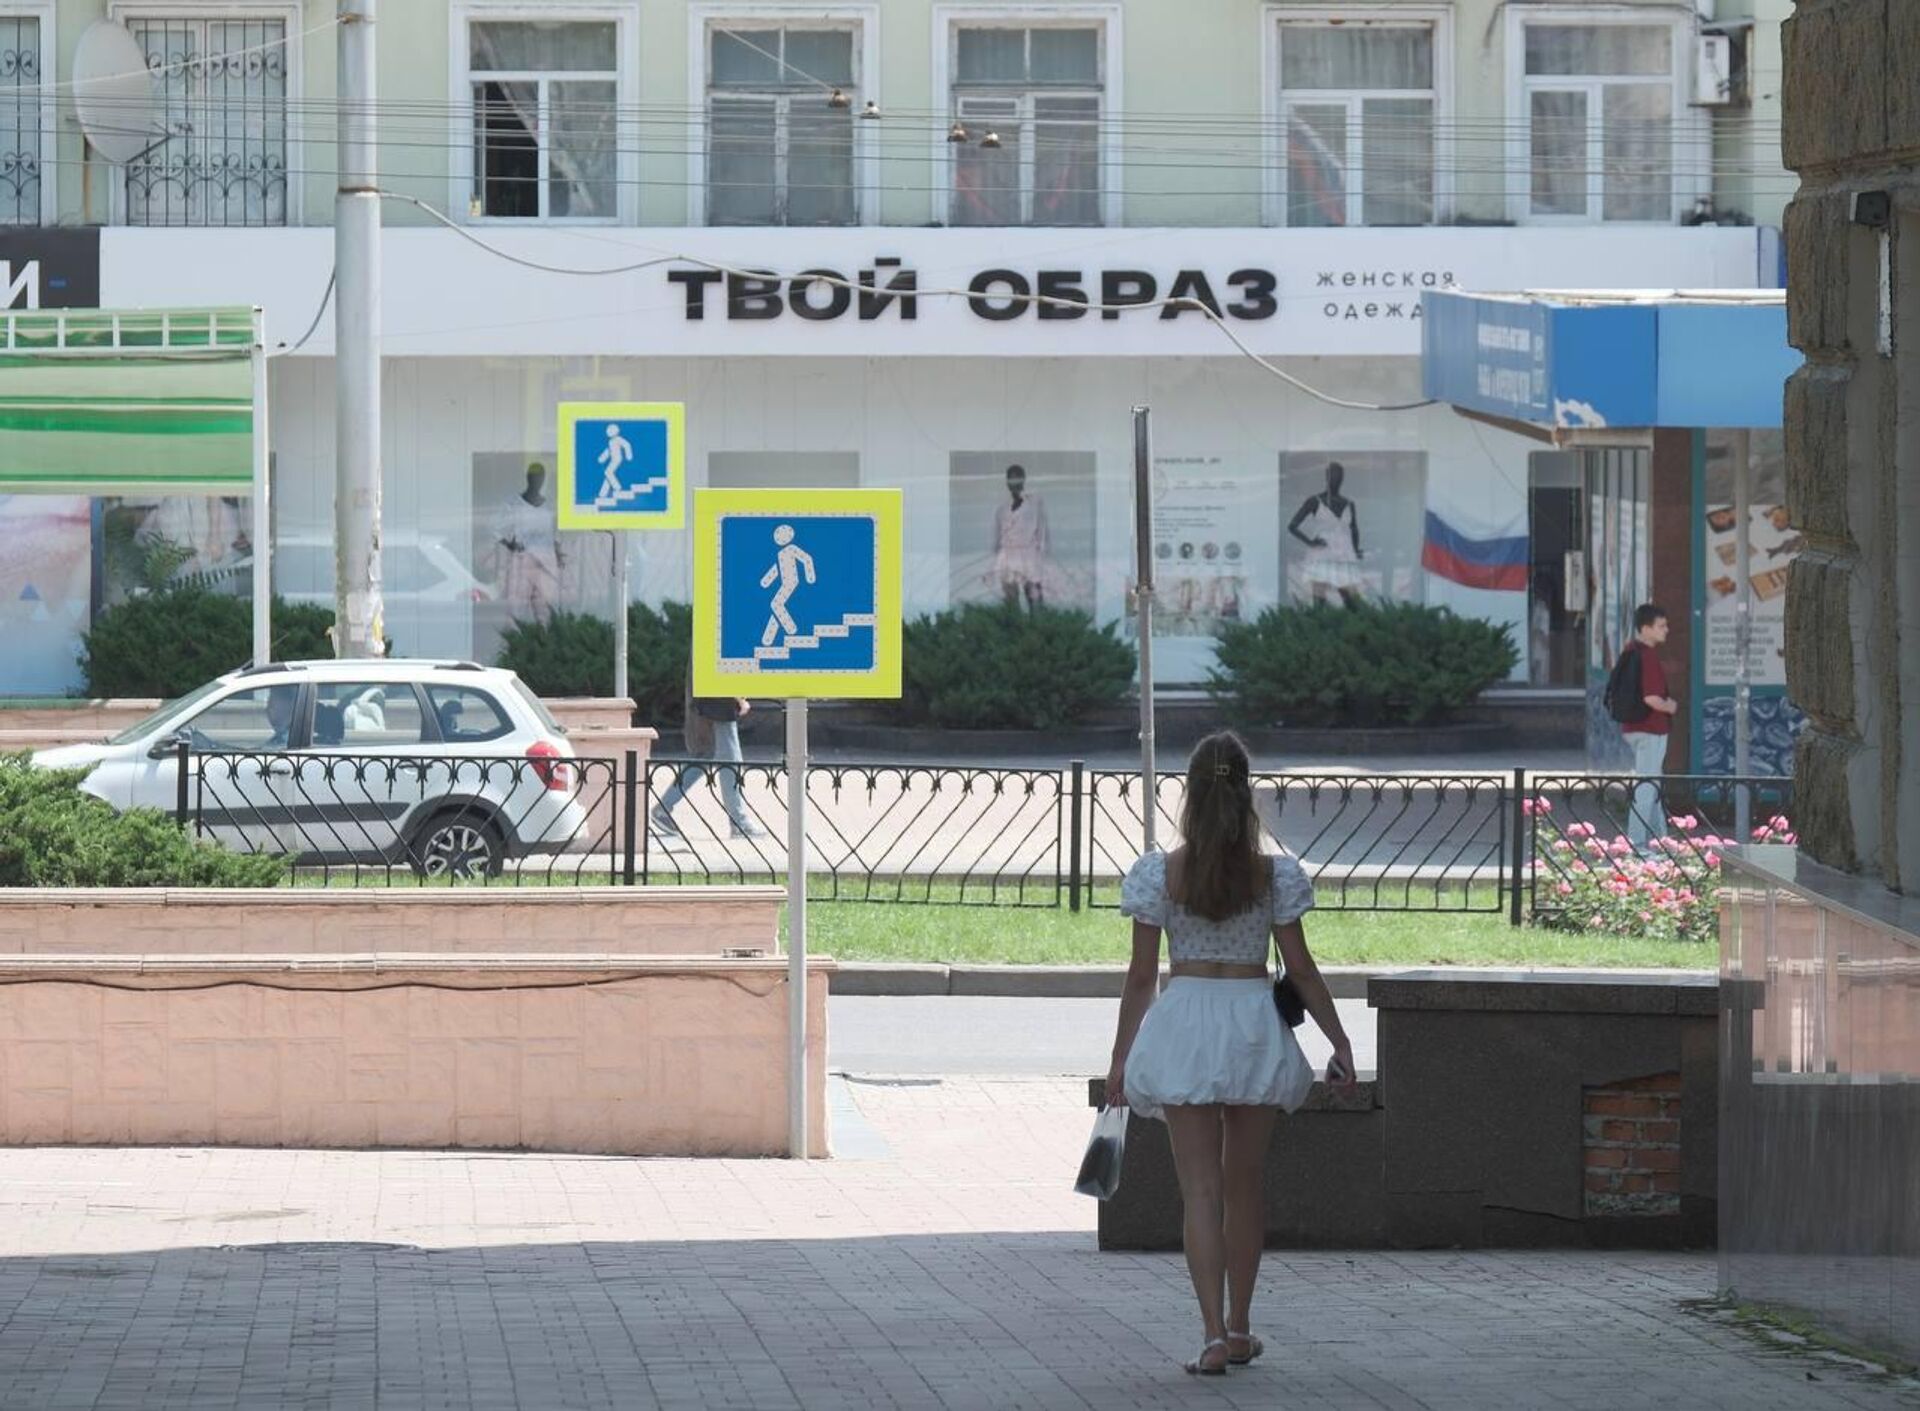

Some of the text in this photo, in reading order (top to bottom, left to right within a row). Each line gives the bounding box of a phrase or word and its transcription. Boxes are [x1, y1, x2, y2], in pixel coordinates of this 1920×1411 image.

[1316, 271, 1454, 286] женская
[667, 257, 1278, 321] ТВОЙ ОБРАЗ
[1323, 303, 1424, 320] одежд
